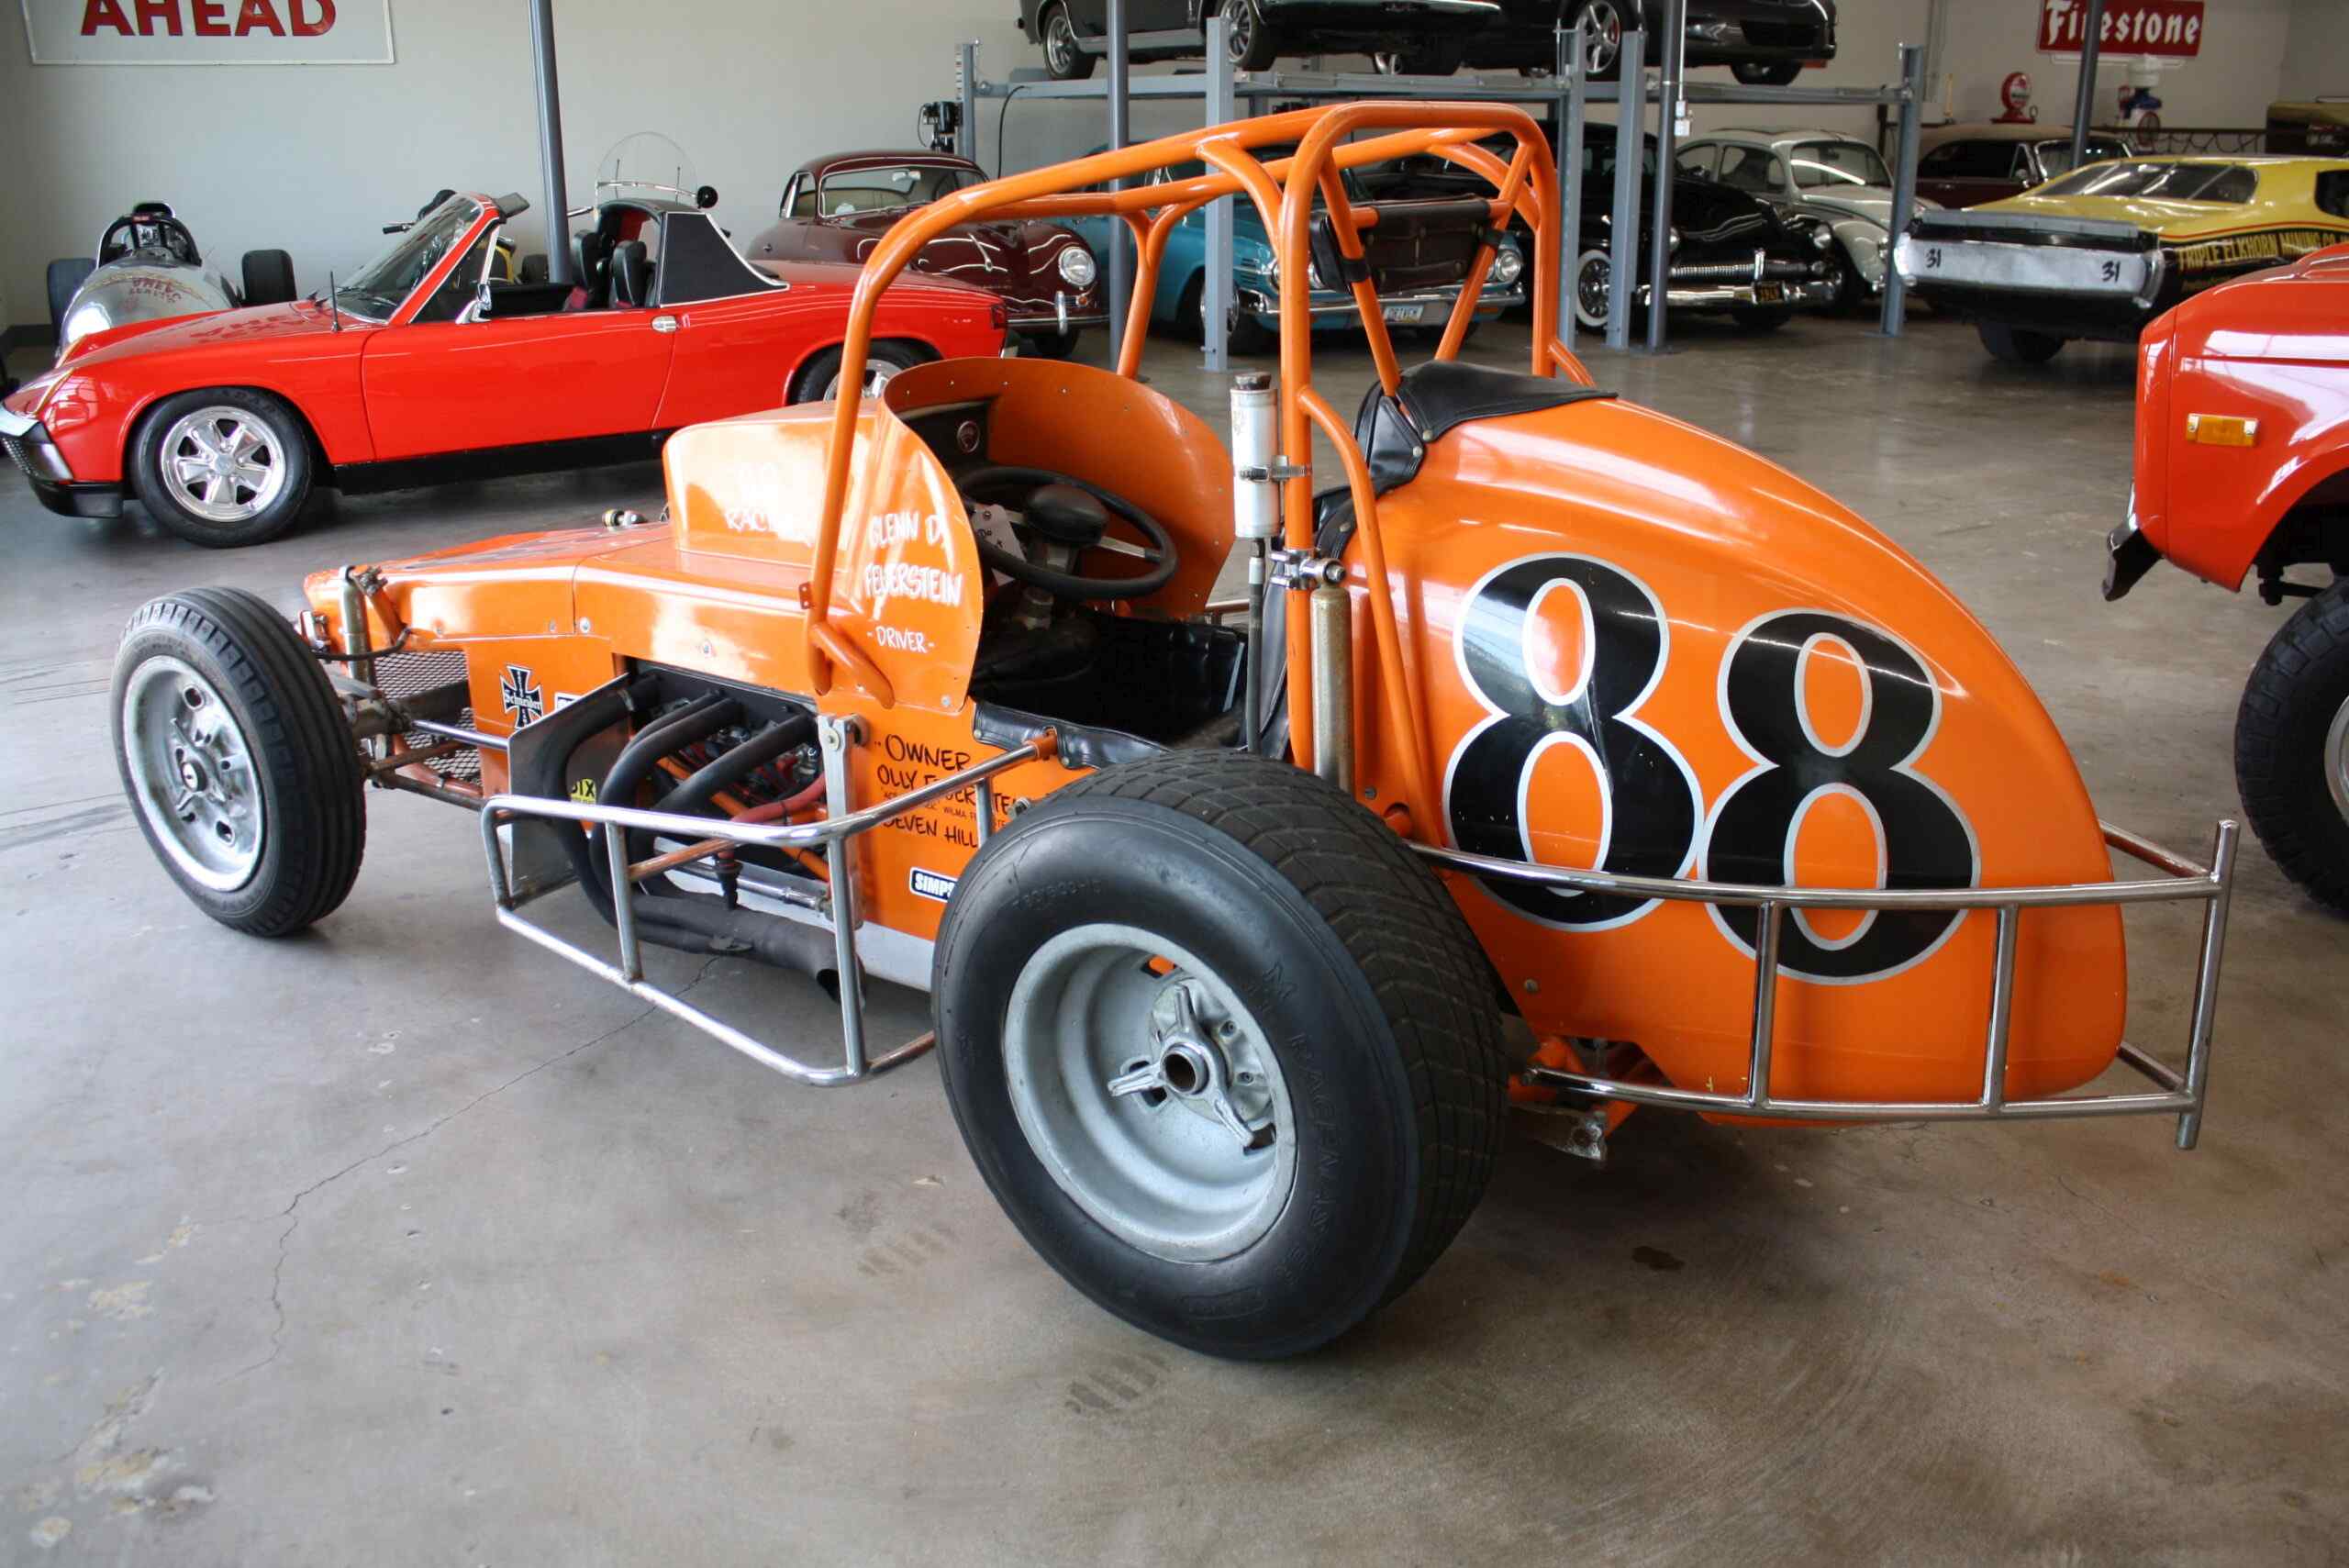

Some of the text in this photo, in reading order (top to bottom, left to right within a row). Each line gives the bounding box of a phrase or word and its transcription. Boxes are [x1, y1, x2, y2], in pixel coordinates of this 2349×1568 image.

[81, 0, 337, 37] AHEAD
[1926, 249, 1942, 268] 31
[2223, 233, 2277, 263] ELKHORN
[2102, 261, 2121, 283] 31
[870, 511, 920, 549] GLENN
[1443, 552, 1980, 984] 88
